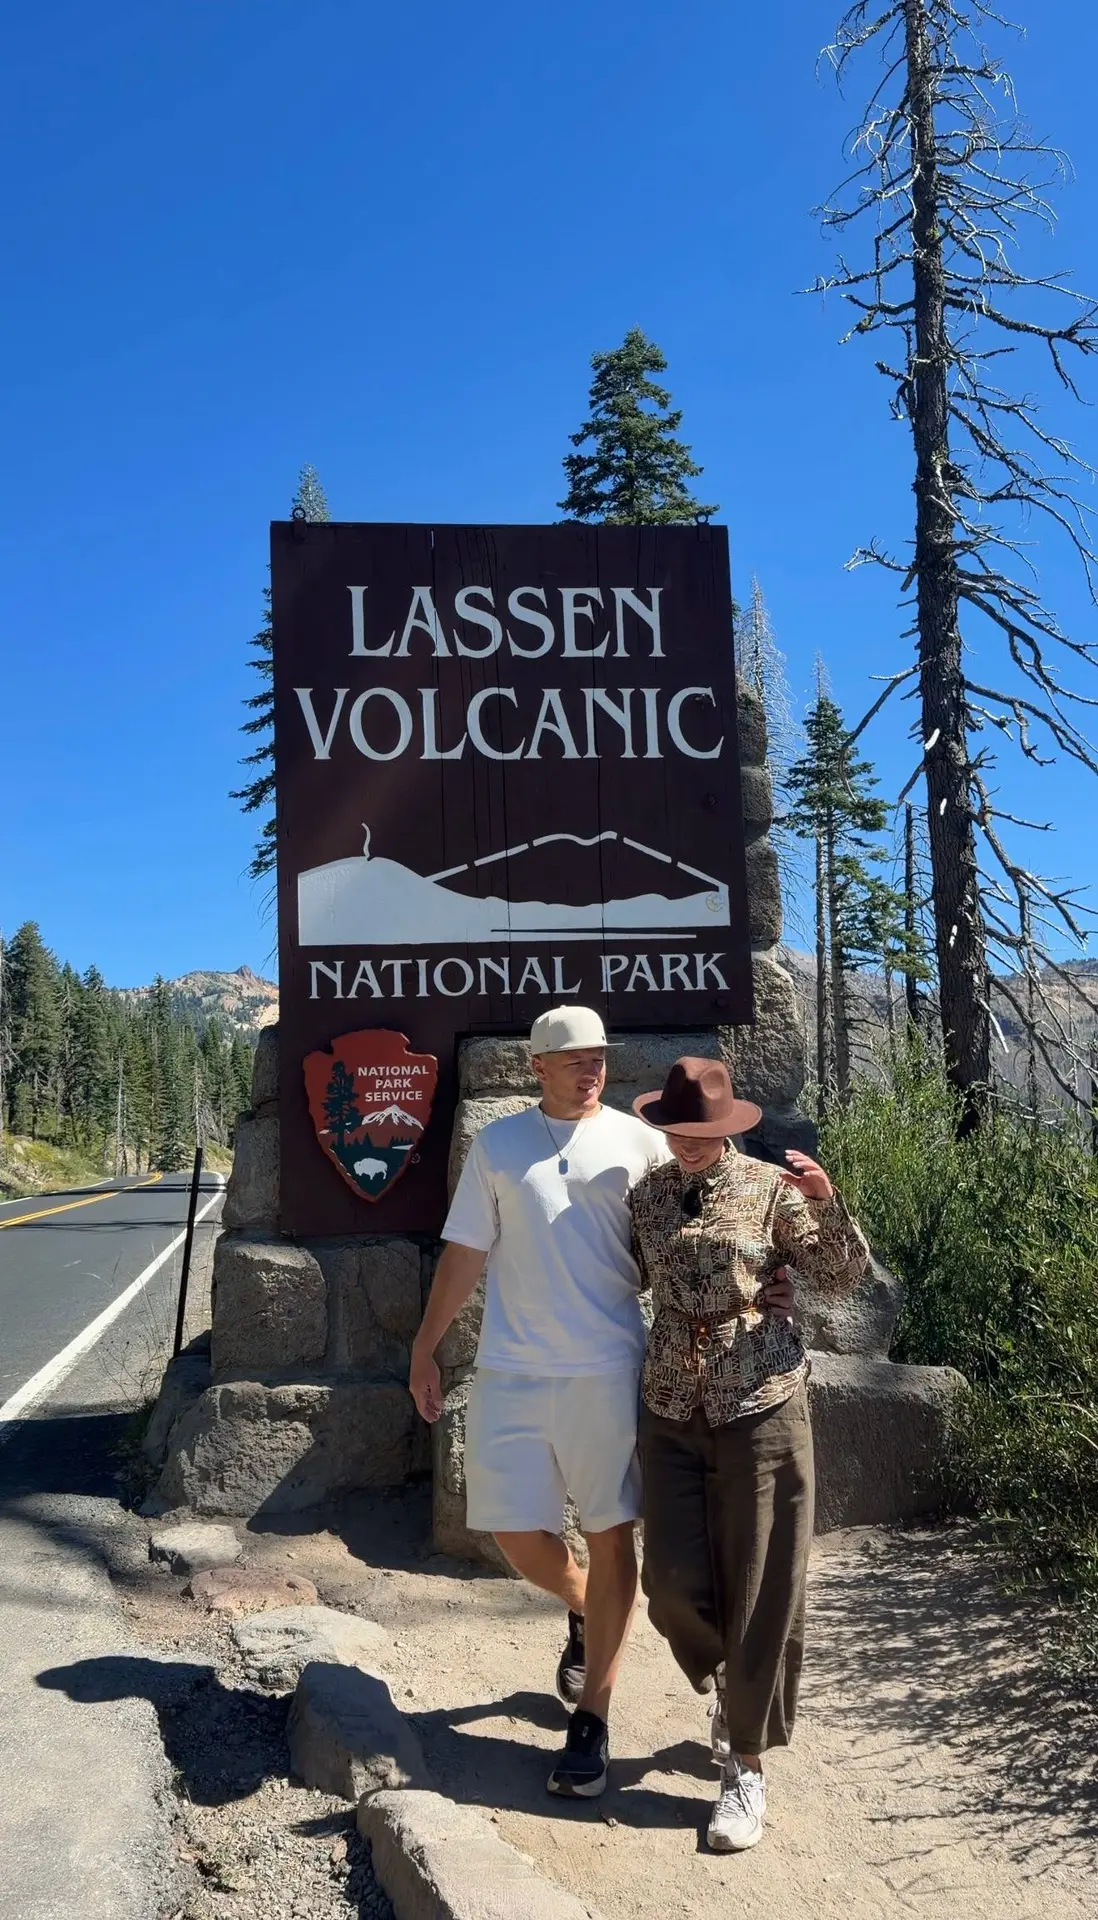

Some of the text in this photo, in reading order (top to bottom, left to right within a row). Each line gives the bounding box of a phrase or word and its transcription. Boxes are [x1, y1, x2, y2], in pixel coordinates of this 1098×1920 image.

[346, 585, 666, 659] LASSEN
[293, 687, 725, 762] VOLCANIC
[308, 952, 731, 1000] NATIONAL PARK
[358, 1065, 430, 1077] NATIONAL
[375, 1078, 412, 1089] PARK
[365, 1091, 423, 1102] SERVICE
